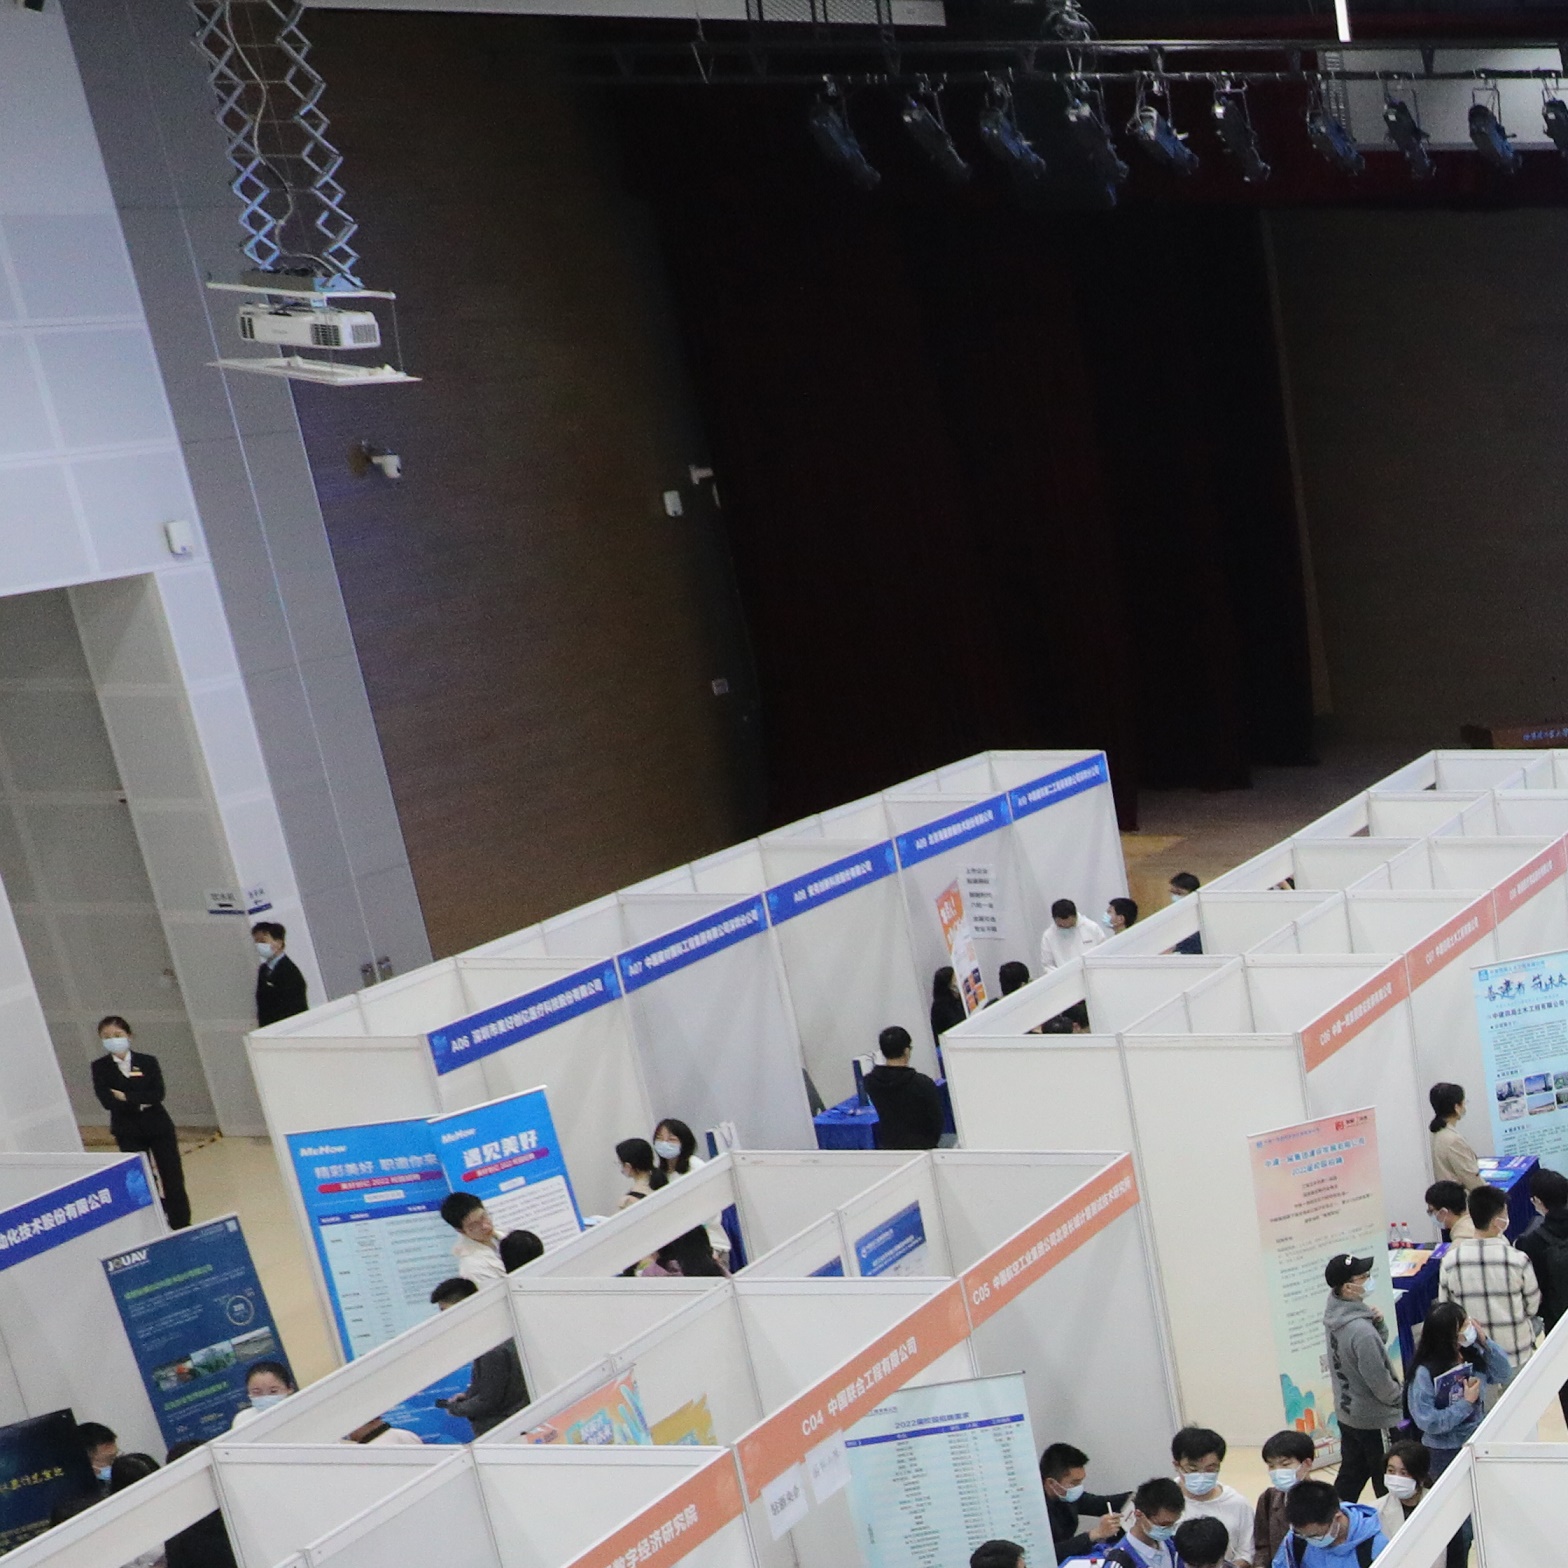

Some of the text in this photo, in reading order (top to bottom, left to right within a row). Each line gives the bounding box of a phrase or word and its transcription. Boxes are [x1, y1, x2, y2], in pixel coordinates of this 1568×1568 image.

[451, 1035, 470, 1053] A06
[463, 1129, 538, 1168] 遇见美好
[313, 1158, 375, 1180] 精彩美好
[107, 1249, 149, 1273] JOUAV
[972, 1282, 992, 1306] C05
[802, 1335, 918, 1437] C04 中国联合工程有限公司
